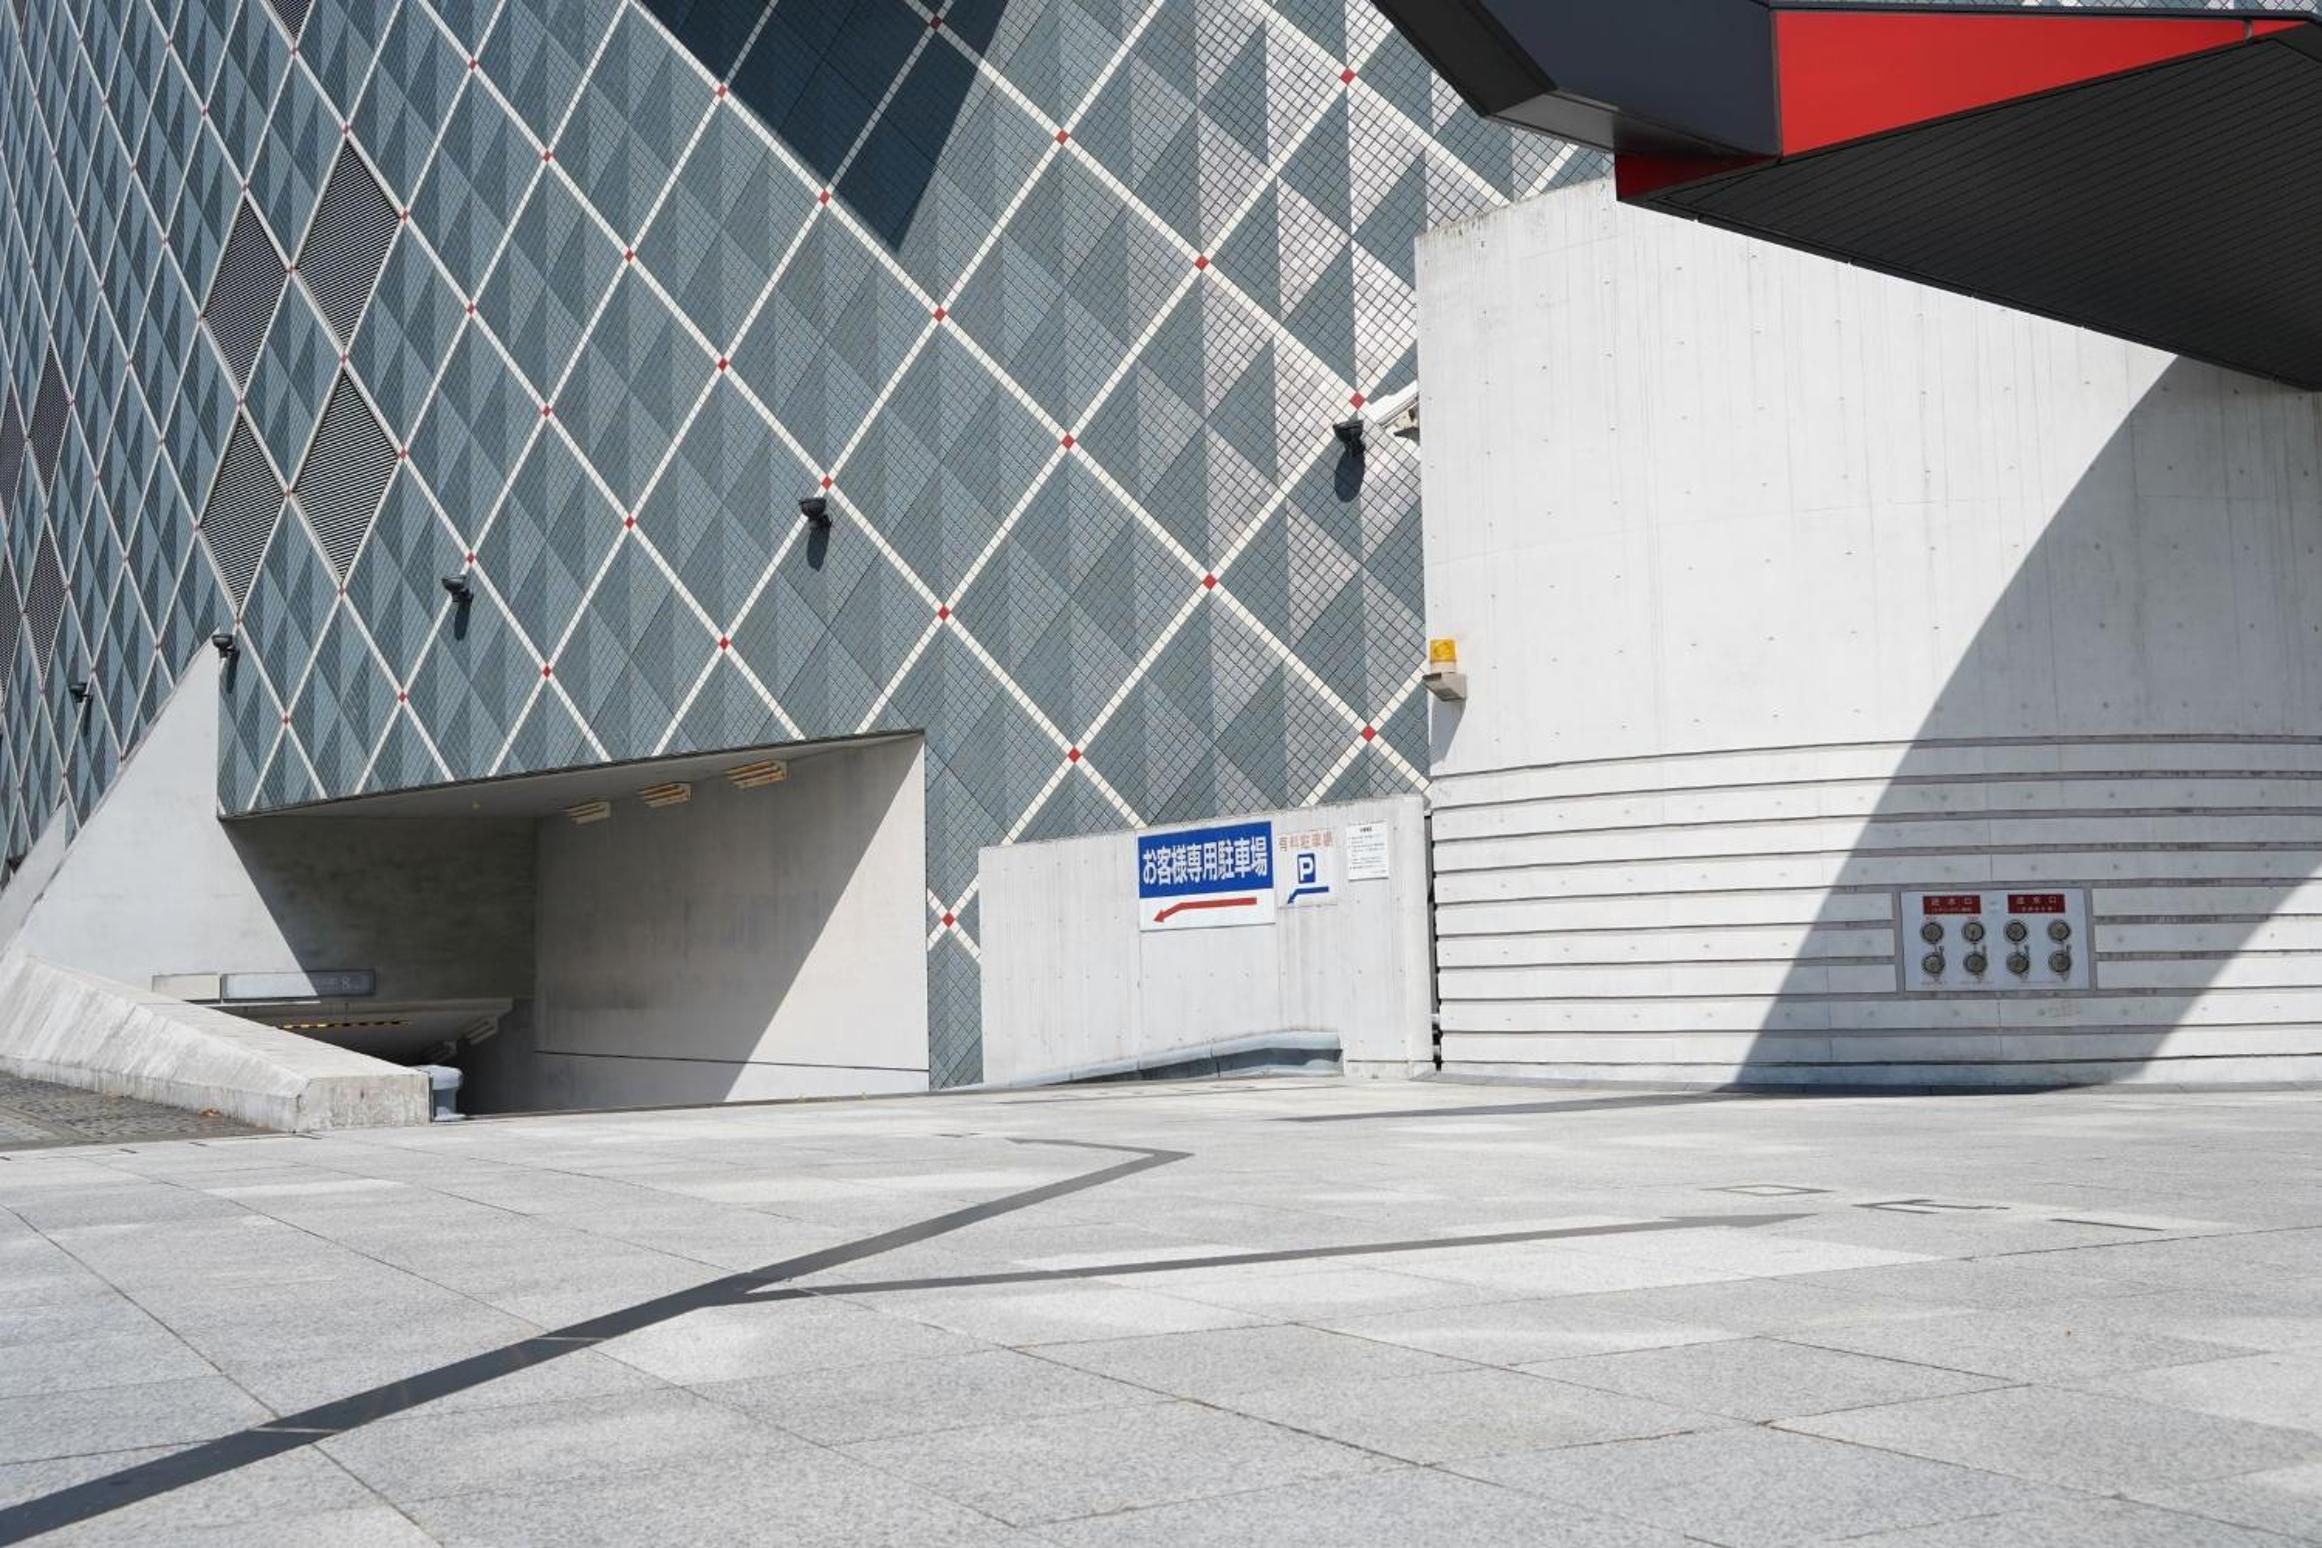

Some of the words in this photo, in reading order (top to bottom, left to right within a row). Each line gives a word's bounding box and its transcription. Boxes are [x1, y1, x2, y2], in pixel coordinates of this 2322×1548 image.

[1143, 836, 1268, 885] お客様専用駐車場
[1298, 856, 1314, 881] P
